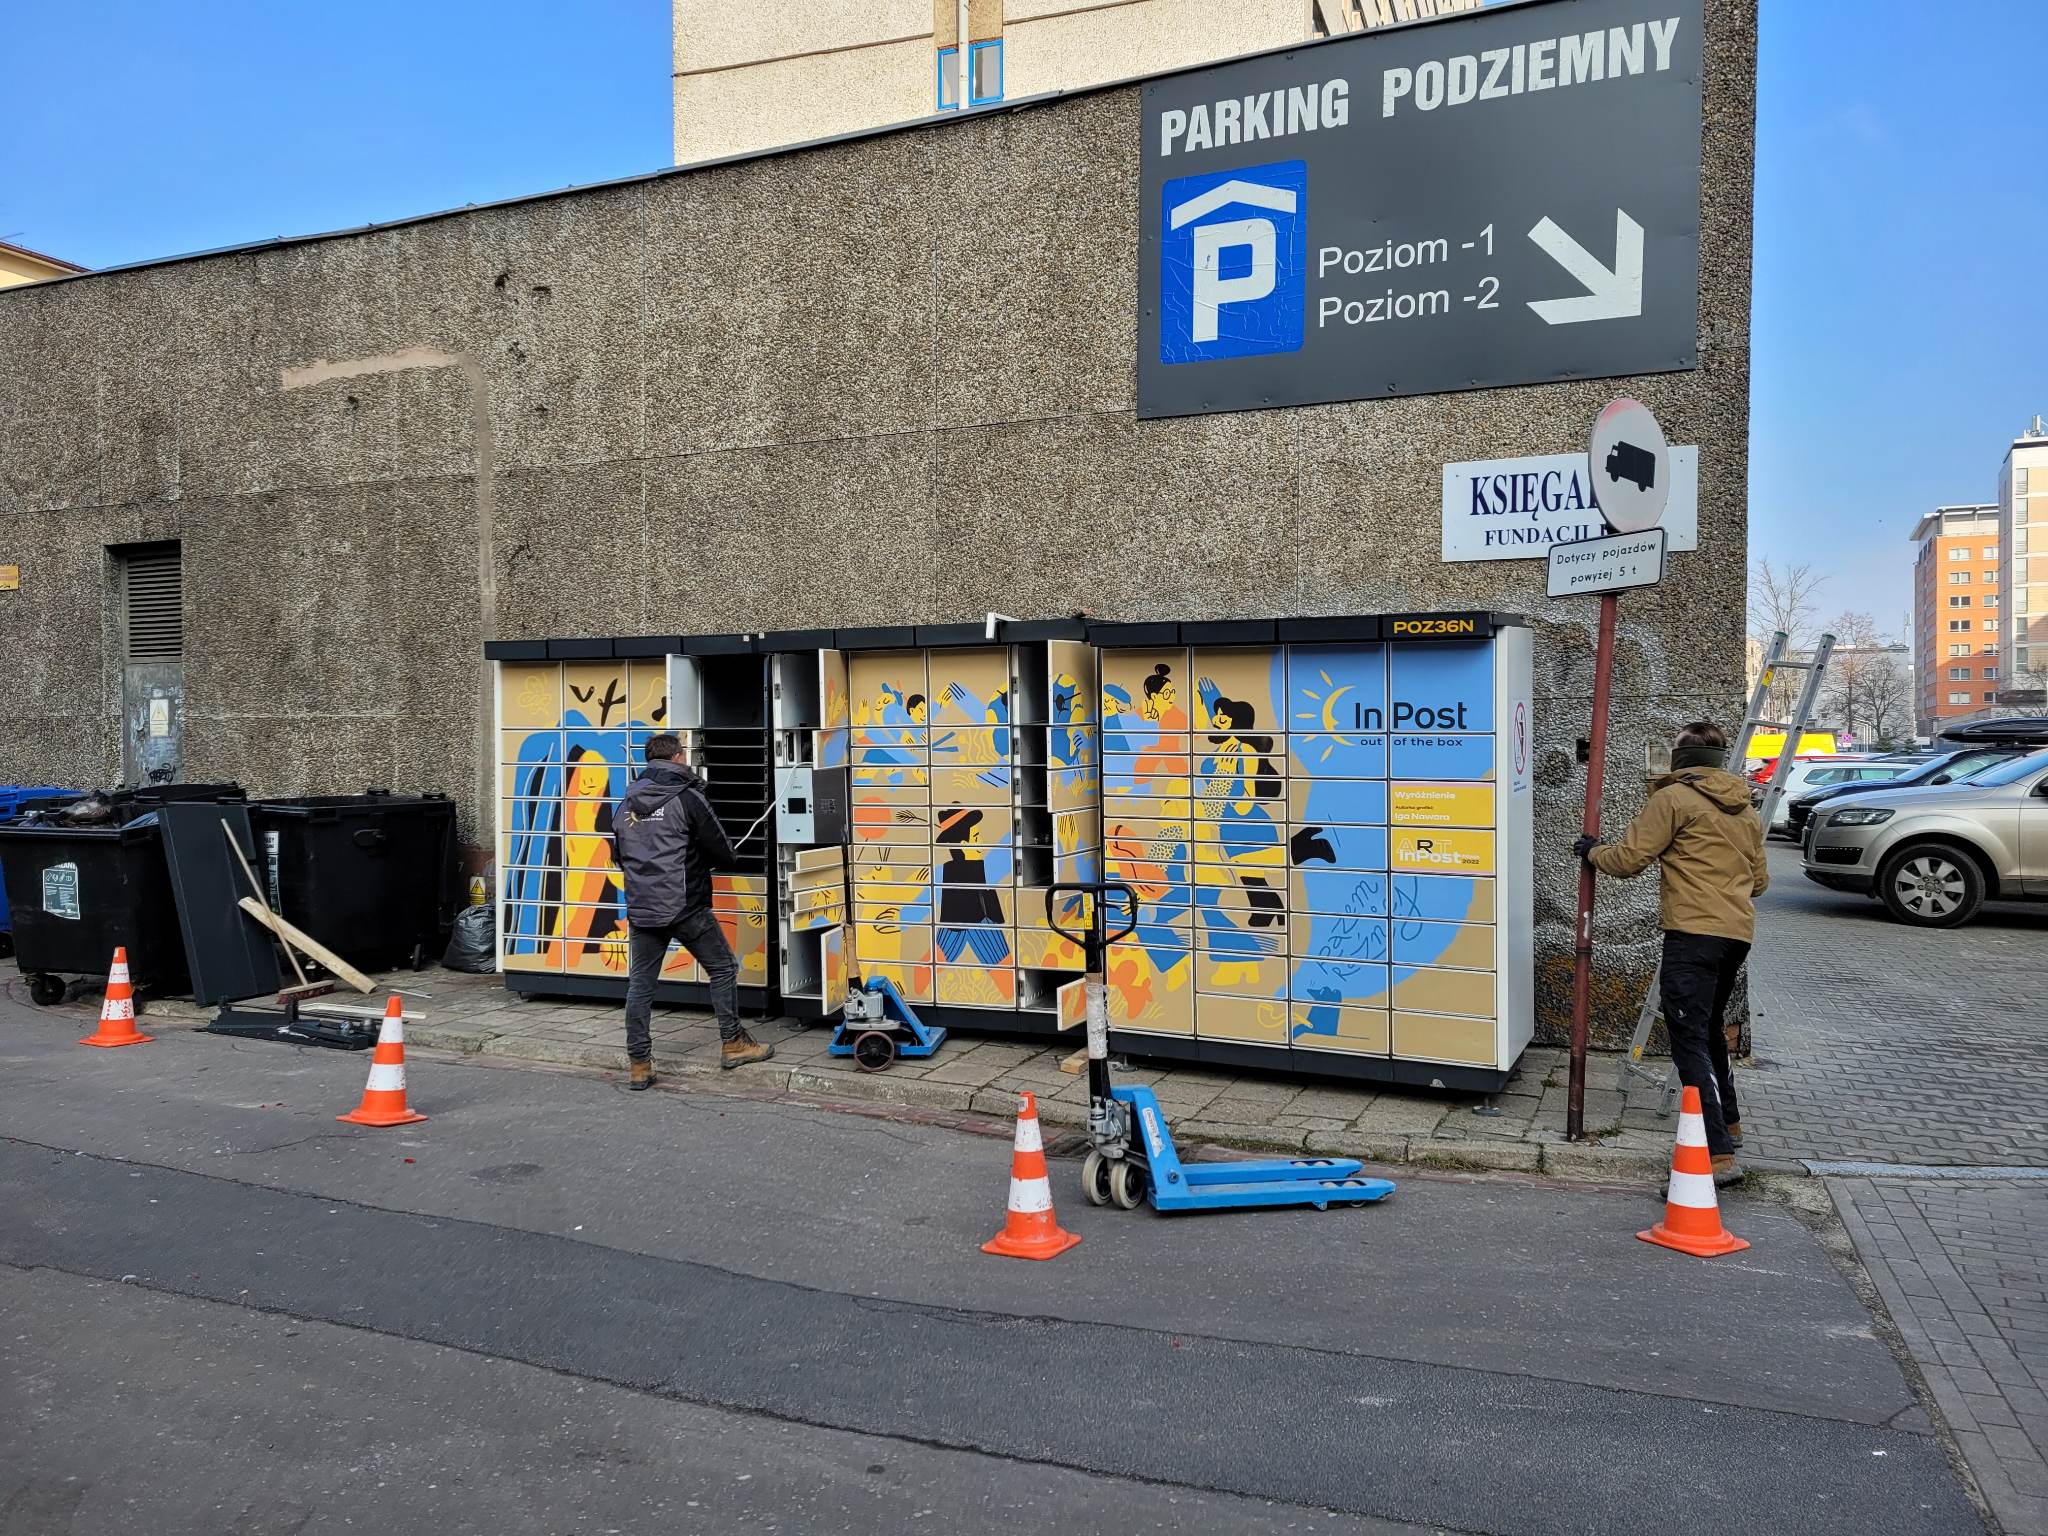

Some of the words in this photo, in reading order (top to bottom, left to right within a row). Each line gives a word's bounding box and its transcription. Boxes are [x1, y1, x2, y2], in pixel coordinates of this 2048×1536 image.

[1161, 78, 1349, 156] PARKING
[1383, 17, 1680, 118] PODZIEMNY
[1319, 237, 1448, 279] Poziom
[1461, 224, 1494, 258] -1
[1193, 218, 1277, 343] P
[1319, 286, 1450, 328] Poziom
[1462, 277, 1500, 311] -2
[1556, 550, 1597, 565] Dotyczy
[1602, 541, 1656, 560] pojazdów
[1570, 567, 1613, 585] powyżej
[1618, 566, 1626, 577] 5
[1632, 565, 1637, 575] t
[1393, 619, 1474, 634] POZ36N
[1360, 737, 1383, 746] out
[1393, 736, 1409, 746] of
[1410, 736, 1433, 746] the
[1437, 736, 1463, 747] box
